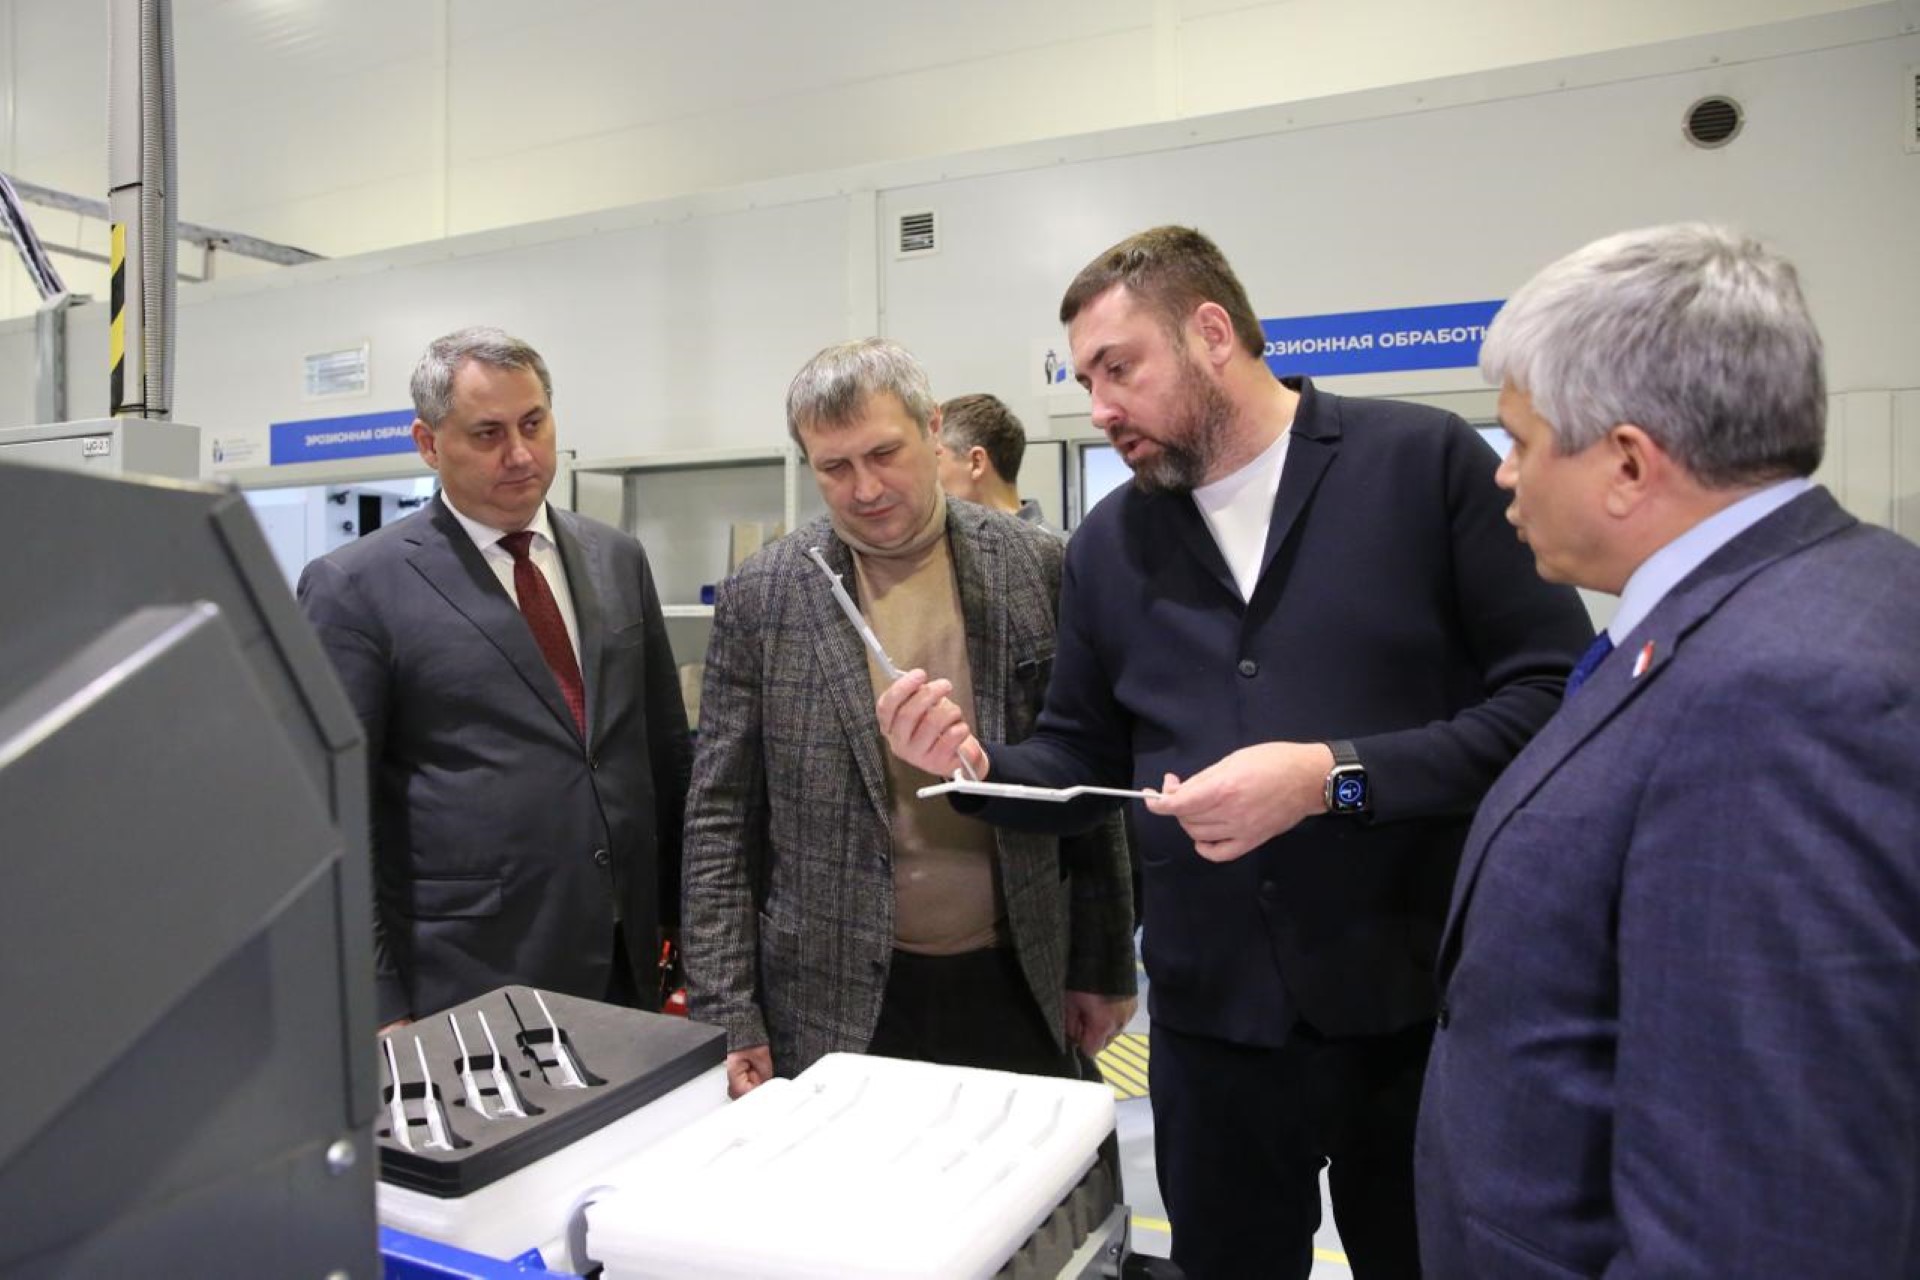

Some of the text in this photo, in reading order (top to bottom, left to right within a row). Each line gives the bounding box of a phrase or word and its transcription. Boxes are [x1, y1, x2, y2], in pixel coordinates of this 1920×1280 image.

[1262, 334, 1374, 357] ОЗИОННАЯ
[304, 425, 412, 447] ЭРОЗИОННАЯ ОБРАБ
